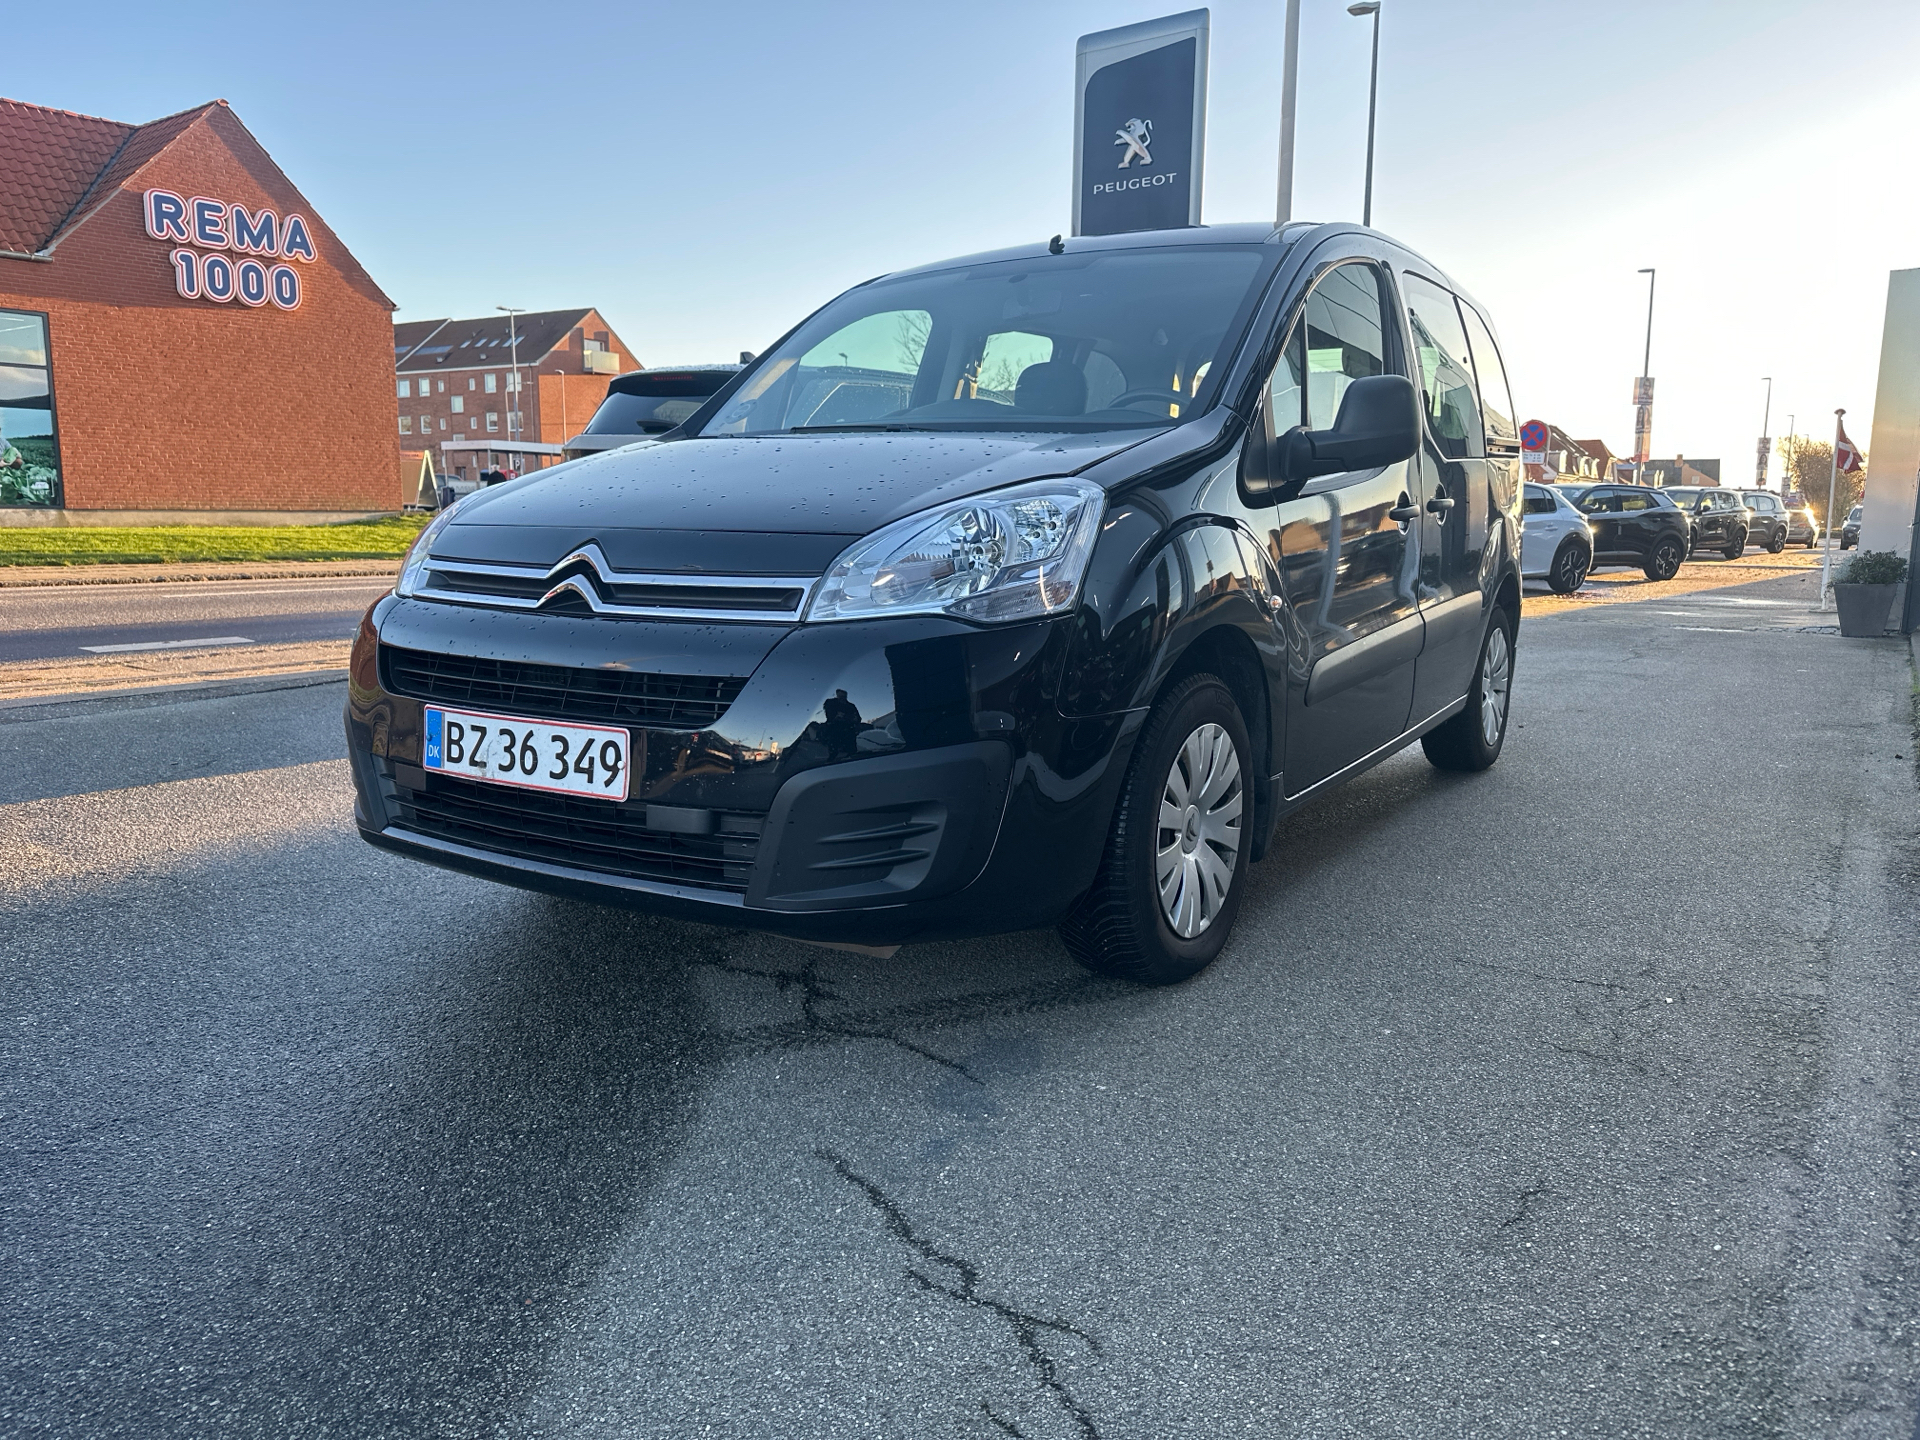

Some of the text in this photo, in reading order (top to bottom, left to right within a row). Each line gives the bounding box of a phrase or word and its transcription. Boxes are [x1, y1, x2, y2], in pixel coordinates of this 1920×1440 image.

[1093, 172, 1177, 195] PEUGEOT
[147, 190, 316, 261] REMA
[172, 250, 301, 309] 1000
[428, 744, 440, 759] DK
[446, 721, 622, 789] BZ 36 349
